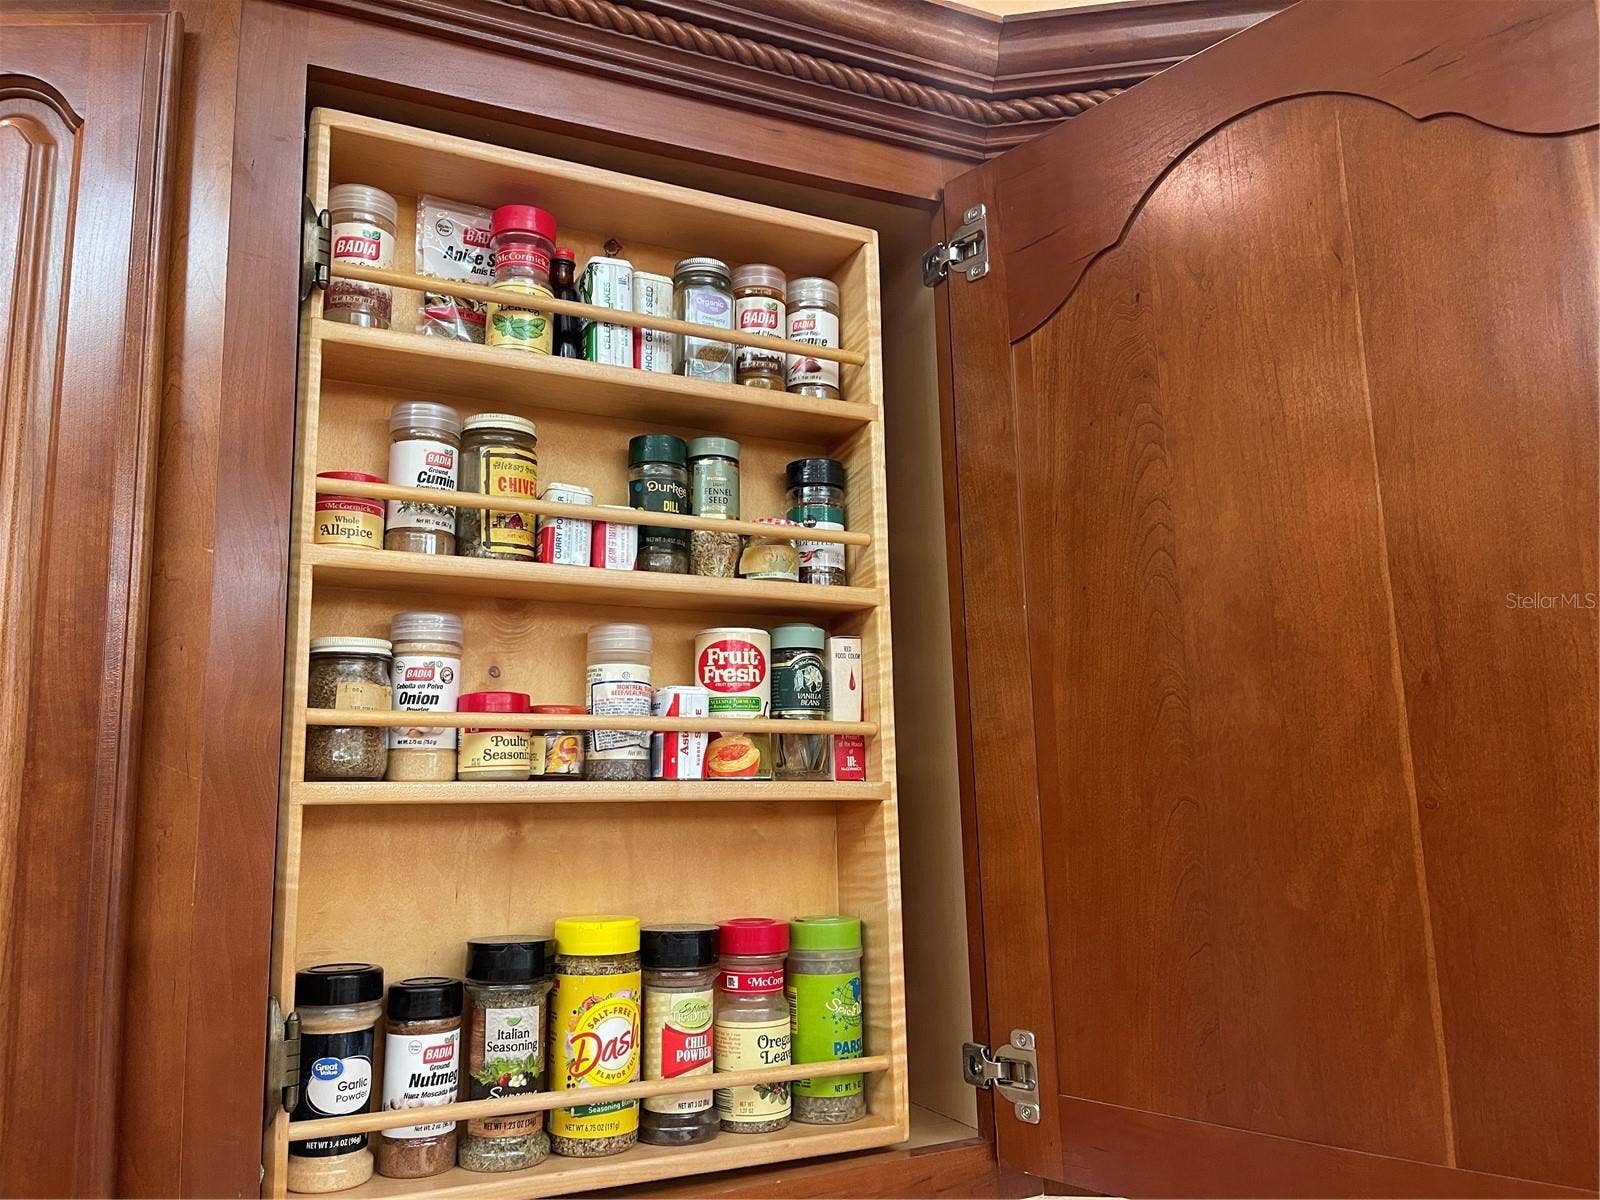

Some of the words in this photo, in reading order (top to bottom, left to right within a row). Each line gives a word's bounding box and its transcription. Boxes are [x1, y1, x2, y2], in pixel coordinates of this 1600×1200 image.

[466, 228, 491, 245] BAD
[336, 239, 377, 257] BADIA
[443, 245, 484, 266] Anise
[496, 251, 547, 267] McCormick
[645, 285, 654, 308] SEED
[696, 297, 725, 311] Organic
[742, 311, 776, 326] BADIA
[793, 320, 815, 331] BADIA
[427, 453, 452, 467] BADIA
[428, 466, 449, 476] Ground
[417, 471, 455, 489] Cumin
[646, 480, 687, 498] Durkee
[704, 487, 732, 497] FENNEL
[324, 501, 375, 514] McCormick
[663, 500, 680, 513] DILL
[708, 496, 729, 505] SEED
[334, 515, 360, 524] Whole
[320, 524, 373, 539] Allspice
[554, 529, 563, 559] CURRY
[835, 652, 846, 660] FOOD
[847, 652, 861, 660] COLOR
[406, 668, 434, 678] BADIA
[703, 664, 761, 684] Fresh
[426, 683, 444, 691] Polvo
[398, 691, 440, 706] Onion
[797, 693, 822, 701] VANILLA
[587, 1006, 632, 1030] SALT-FREE
[497, 1027, 530, 1041] Italian
[486, 1040, 538, 1053] Seasoning
[569, 1012, 640, 1077] Dash
[685, 1034, 707, 1049] CHILI
[833, 1039, 862, 1056] PARS
[425, 1046, 453, 1060] BADIA
[676, 1046, 712, 1063] POWDER
[315, 1062, 339, 1072] Great
[321, 1069, 339, 1077] Value
[429, 1061, 451, 1071] Ground
[408, 1069, 458, 1088] Nutmeg
[596, 1068, 626, 1080] FLAVOR
[337, 1077, 368, 1092] Garlic
[835, 1083, 843, 1092] NET
[335, 1089, 368, 1103] Powder
[421, 1089, 448, 1099] Moscada
[588, 1102, 621, 1114] Seasoning
[678, 1102, 687, 1110] NET
[687, 1101, 694, 1109] WT
[483, 1121, 492, 1131] NET
[493, 1121, 502, 1130] WT
[516, 1119, 524, 1129] OZ
[565, 1123, 575, 1132] NET
[575, 1124, 584, 1133] WT
[597, 1123, 605, 1132] OZ
[306, 1141, 317, 1150] NET
[318, 1141, 328, 1149] WT
[329, 1140, 339, 1149] 3.4
[340, 1138, 348, 1147] OZ
